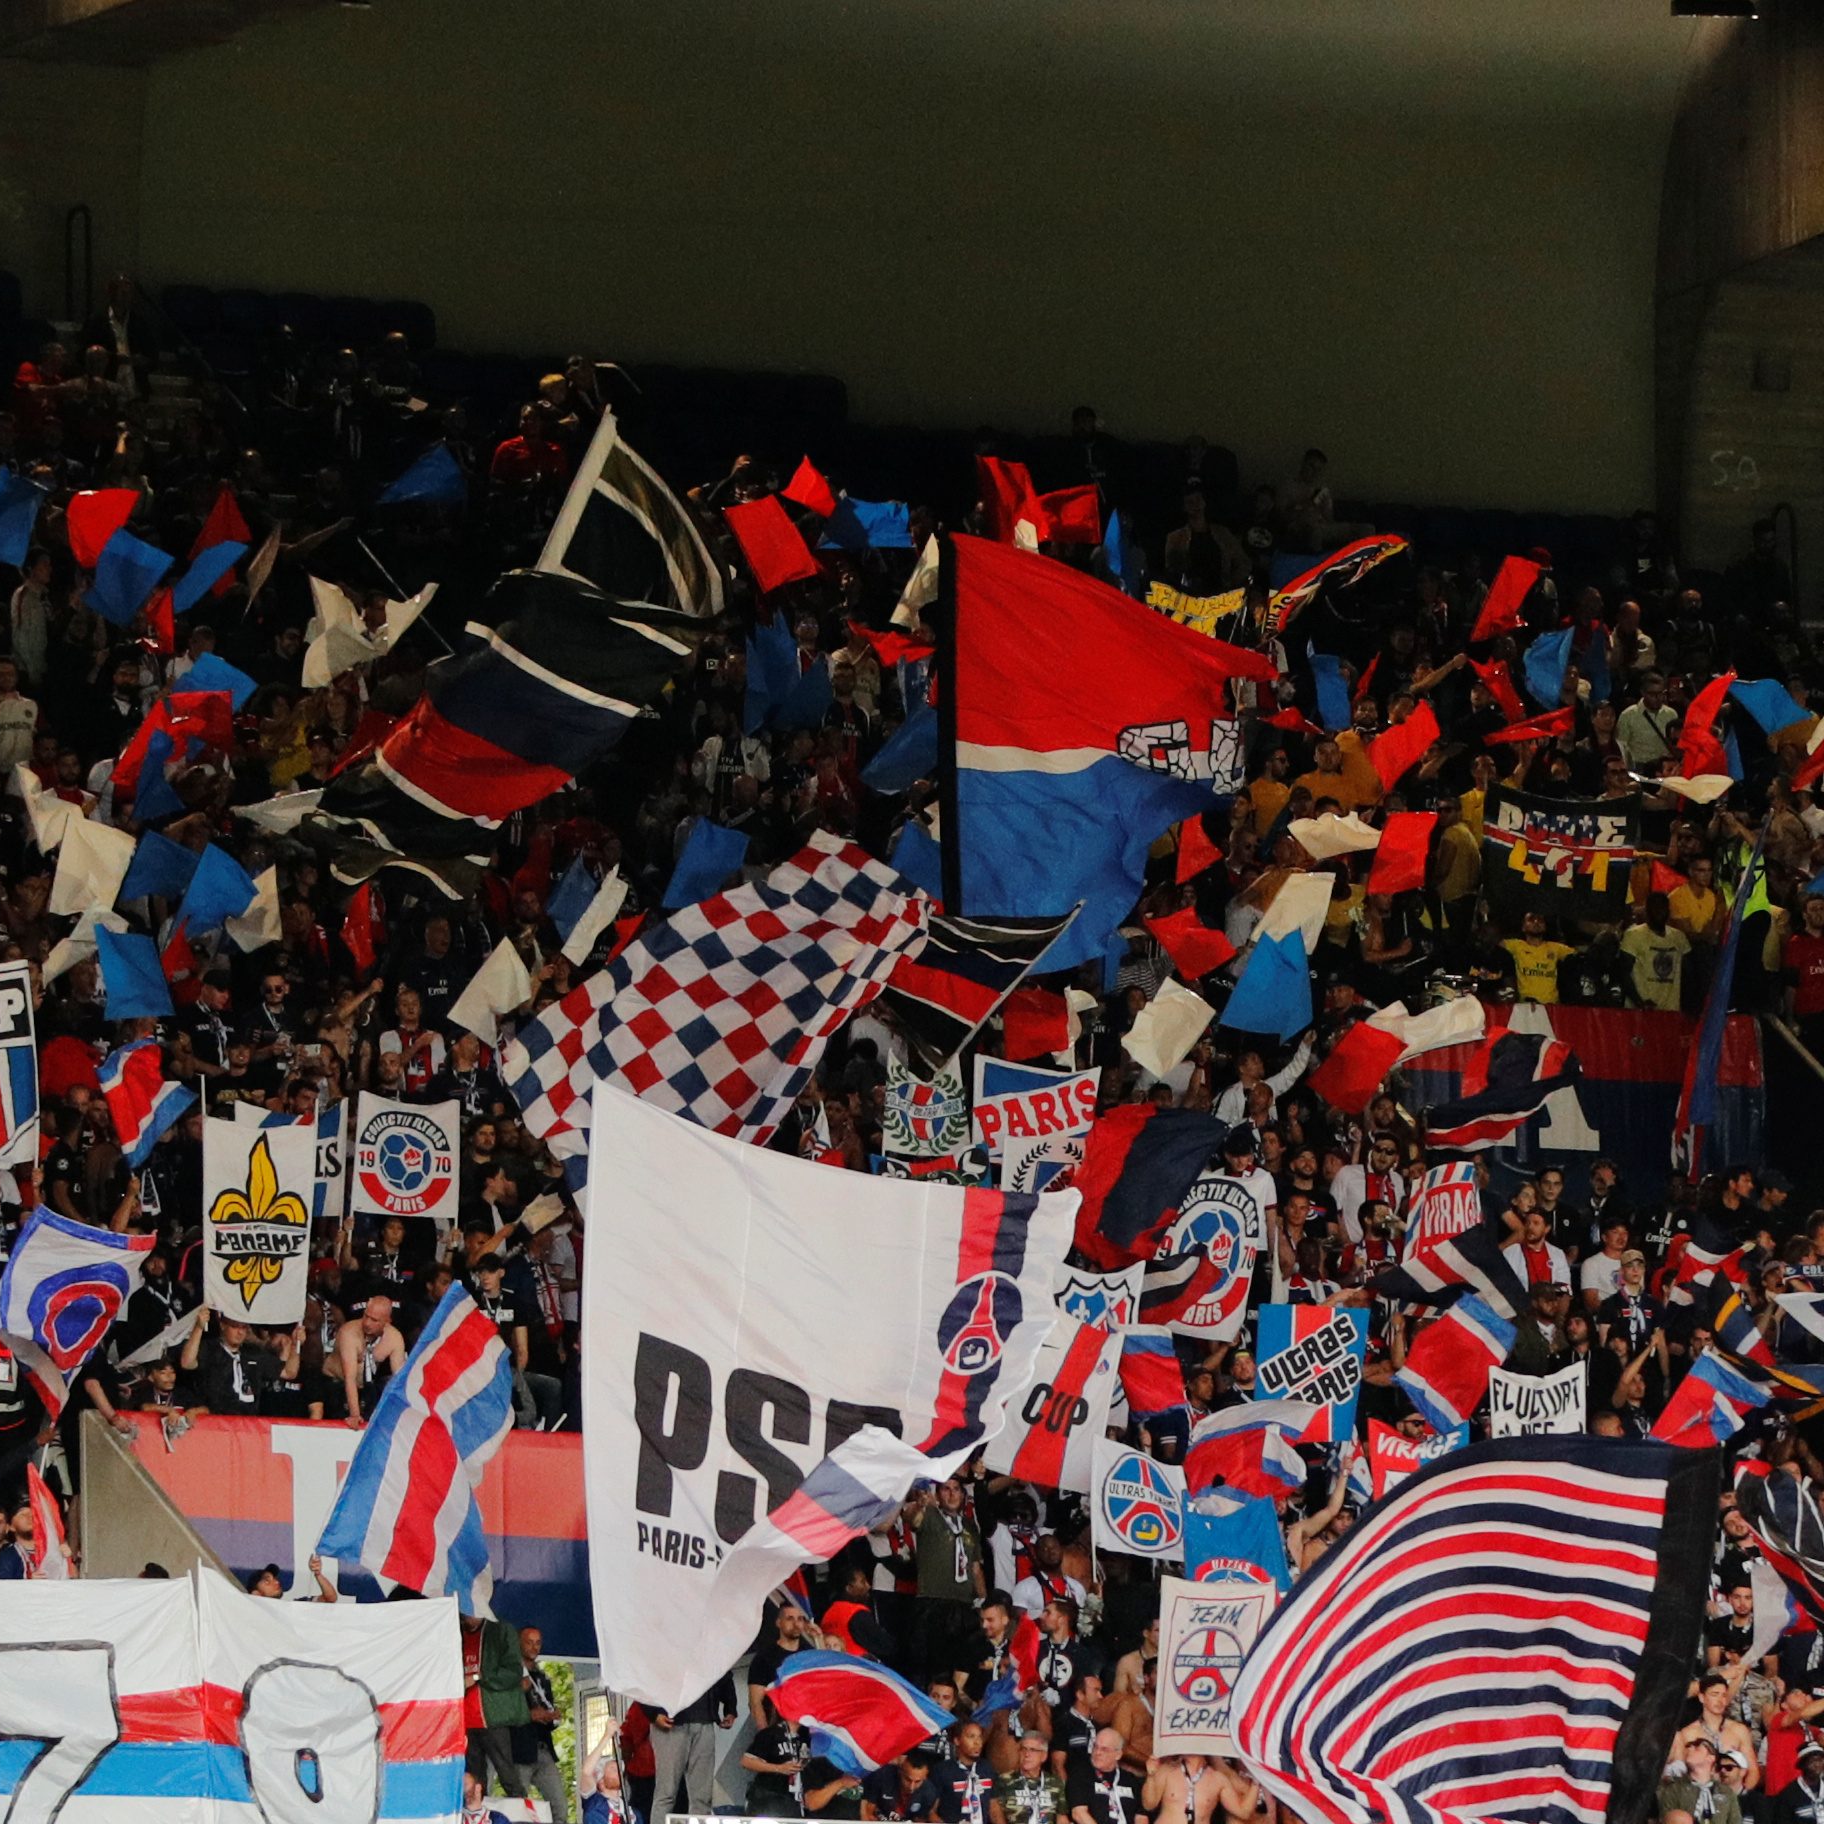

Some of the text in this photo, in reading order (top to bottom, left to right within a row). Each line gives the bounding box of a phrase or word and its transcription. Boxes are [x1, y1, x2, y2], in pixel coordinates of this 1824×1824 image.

[973, 1079, 1096, 1149] PARIS
[358, 1150, 375, 1168] 19
[434, 1156, 451, 1173] 70
[385, 1195, 426, 1213] PARIS
[1241, 1246, 1256, 1269] 70
[1020, 1382, 1089, 1437] CUP
[632, 1331, 904, 1541] PS
[1377, 1431, 1462, 1460] VIRAGE
[1108, 1481, 1146, 1498] ULTRAS
[1188, 1603, 1245, 1625] TEAM
